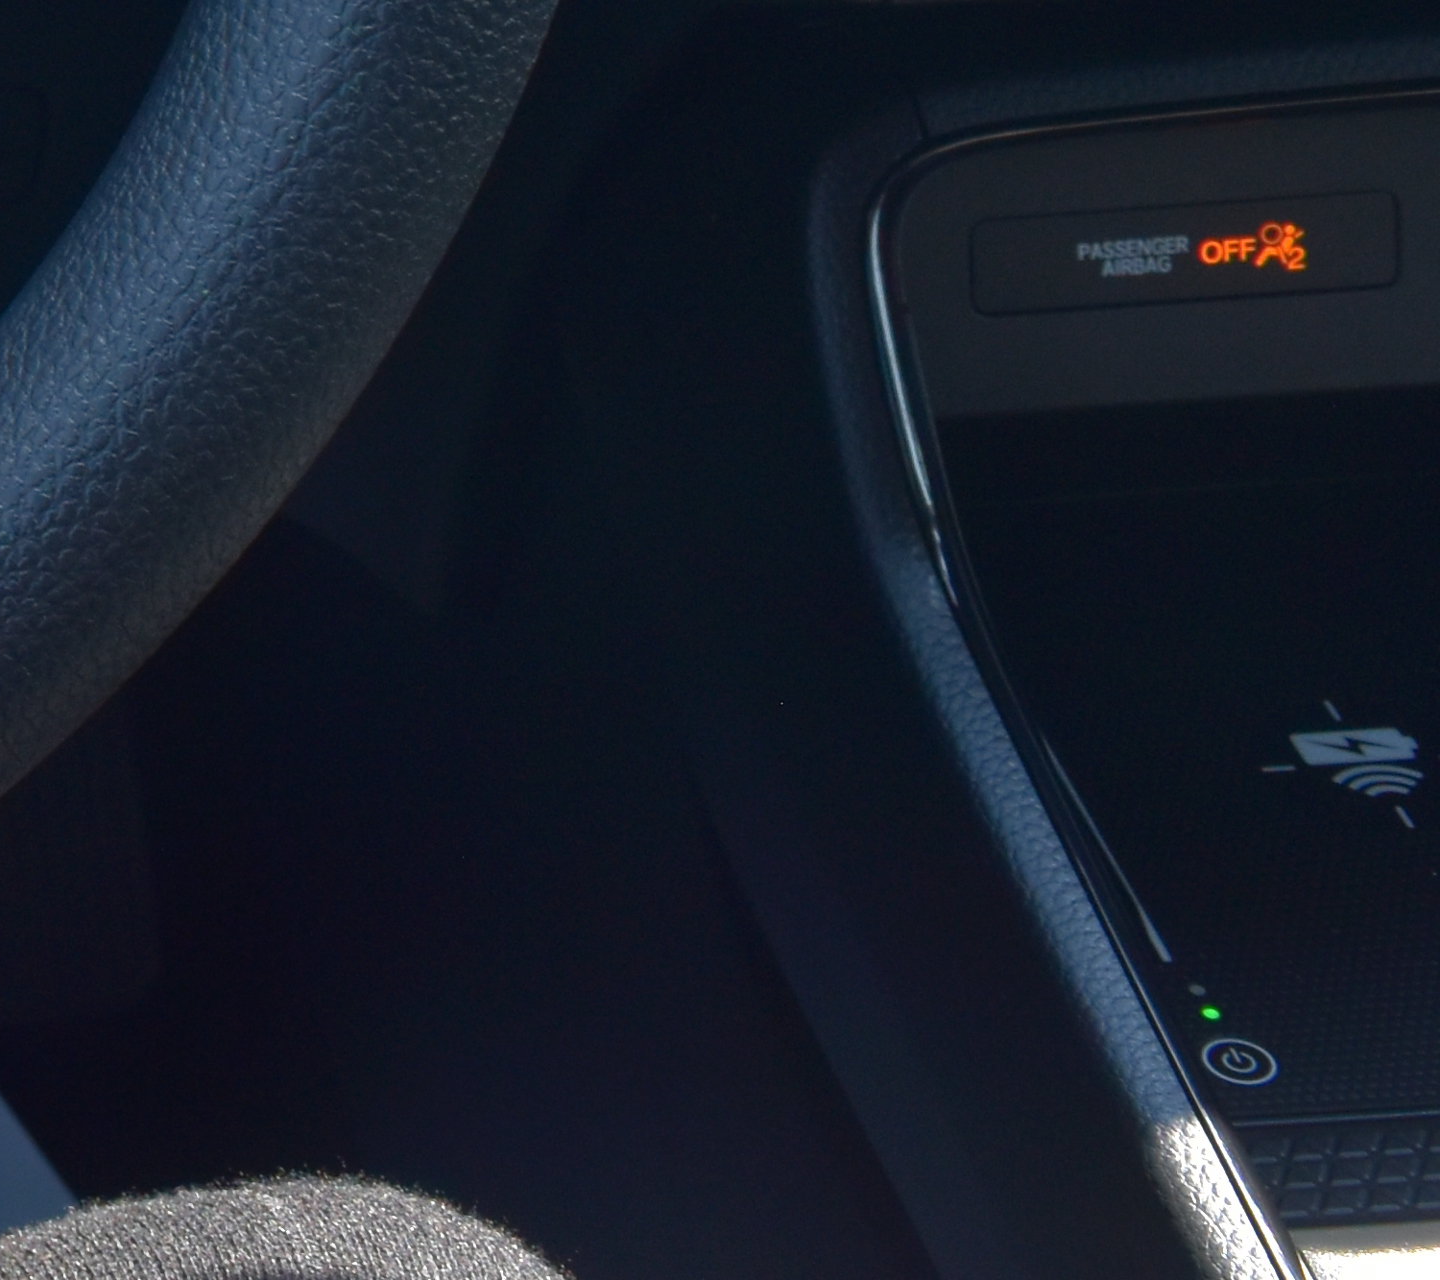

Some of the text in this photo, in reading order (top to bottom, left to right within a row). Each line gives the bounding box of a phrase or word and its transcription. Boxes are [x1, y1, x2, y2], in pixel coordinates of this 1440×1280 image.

[1077, 235, 1189, 261] PASSENGER
[1200, 238, 1256, 265] OFF
[1101, 256, 1172, 277] AIRBAG
